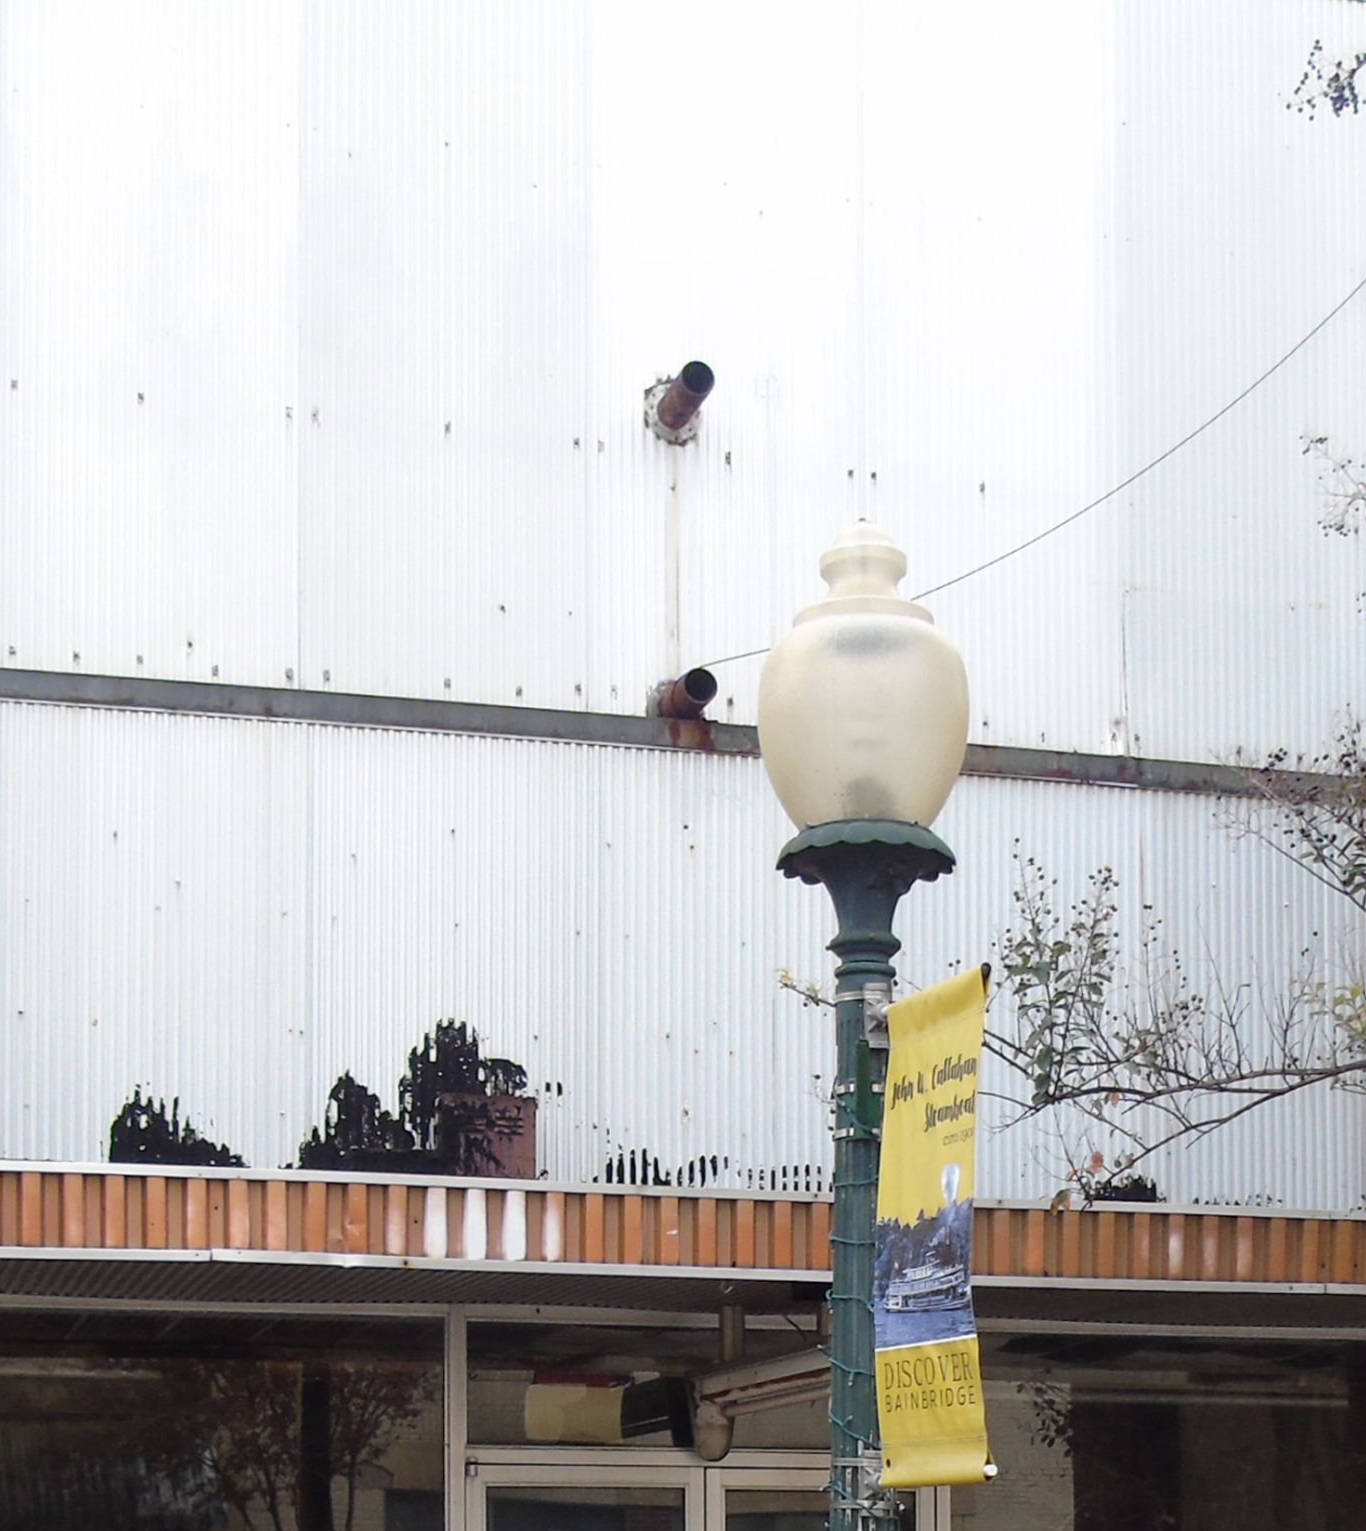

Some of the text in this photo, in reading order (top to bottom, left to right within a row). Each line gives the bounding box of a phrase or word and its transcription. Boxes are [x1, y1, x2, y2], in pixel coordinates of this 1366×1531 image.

[891, 1074, 914, 1110] John
[932, 1053, 977, 1090] Callahan
[884, 1352, 973, 1390] DISCOVER
[885, 1385, 976, 1413] BAINBRIDGE
